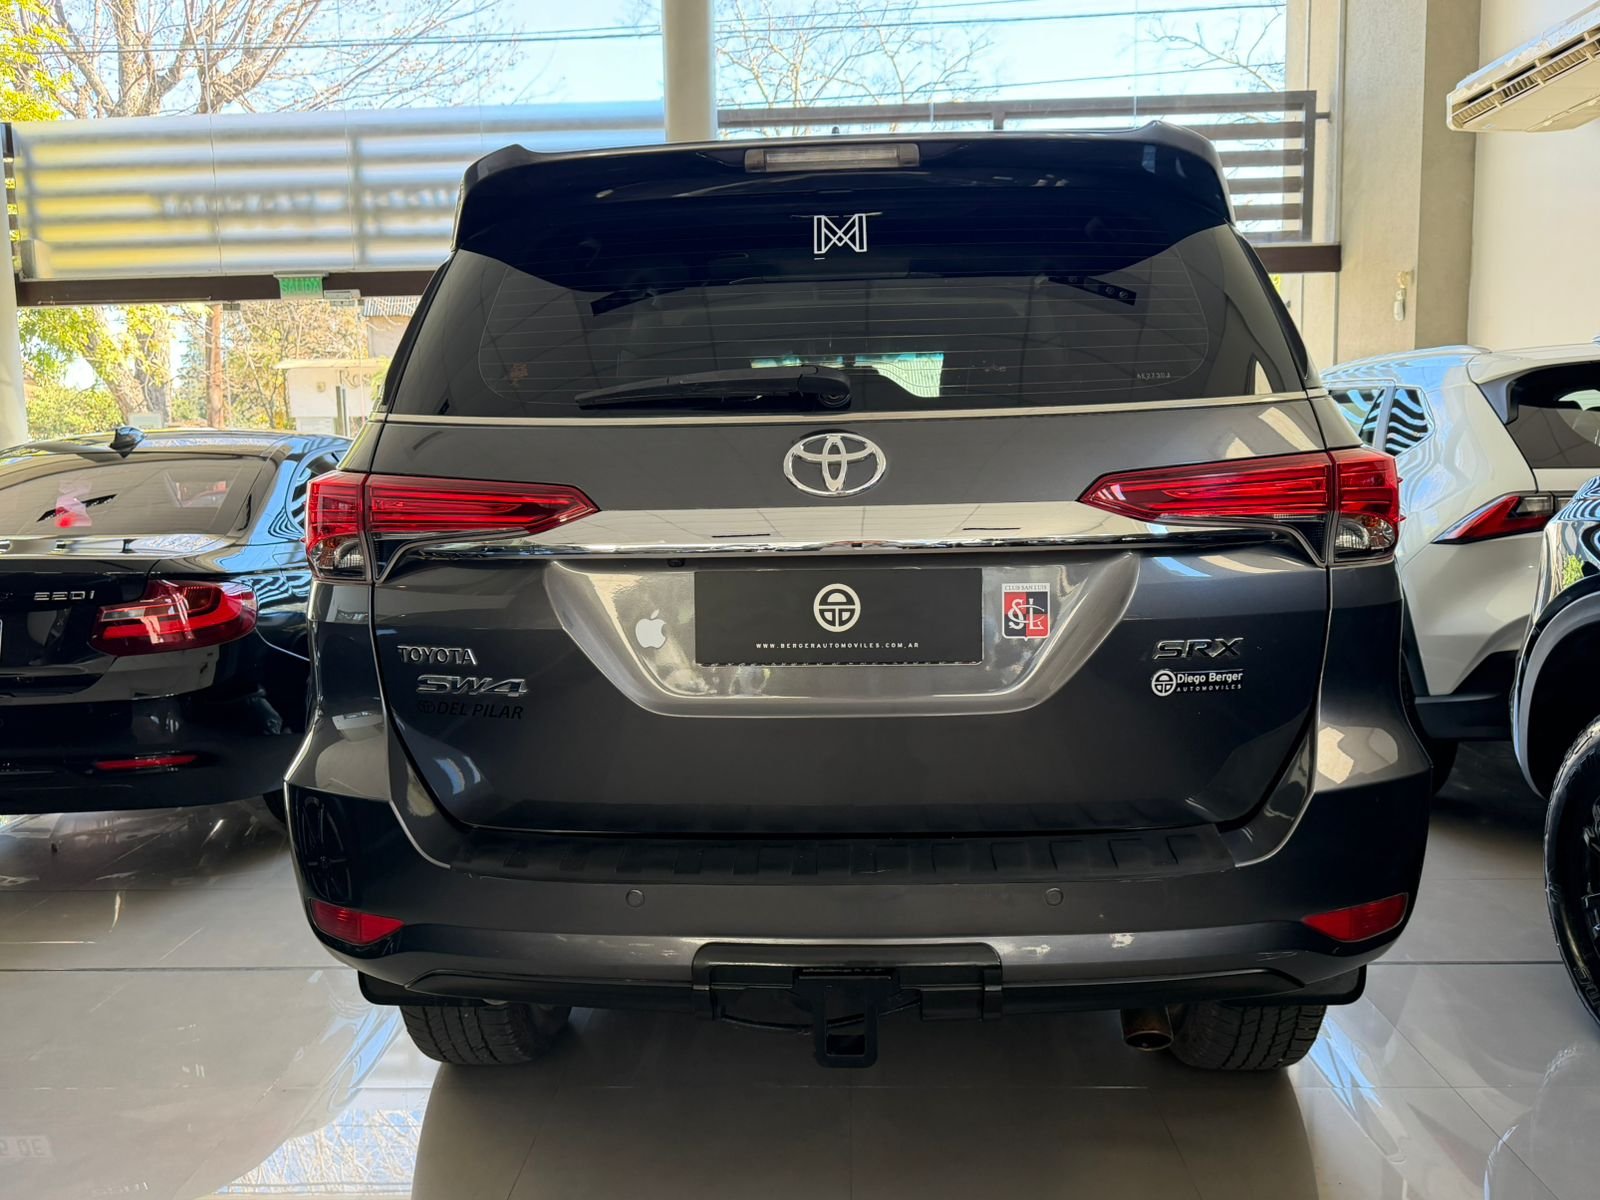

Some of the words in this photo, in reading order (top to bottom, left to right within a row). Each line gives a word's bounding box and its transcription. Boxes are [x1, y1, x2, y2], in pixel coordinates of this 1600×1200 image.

[281, 278, 320, 294] SALIDA
[335, 368, 373, 390] Ros
[397, 645, 478, 666] TOYOTA
[755, 642, 920, 650] WWW.BERGERAUTOMOVILES.COM.AR
[1152, 637, 1244, 660] SRX
[415, 674, 529, 697] SW4
[1176, 684, 1242, 692] AUTOMOVILES
[1177, 673, 1206, 685] Diego
[1208, 672, 1243, 684] Berger
[436, 701, 468, 716] DEL
[472, 703, 524, 720] PILAR
